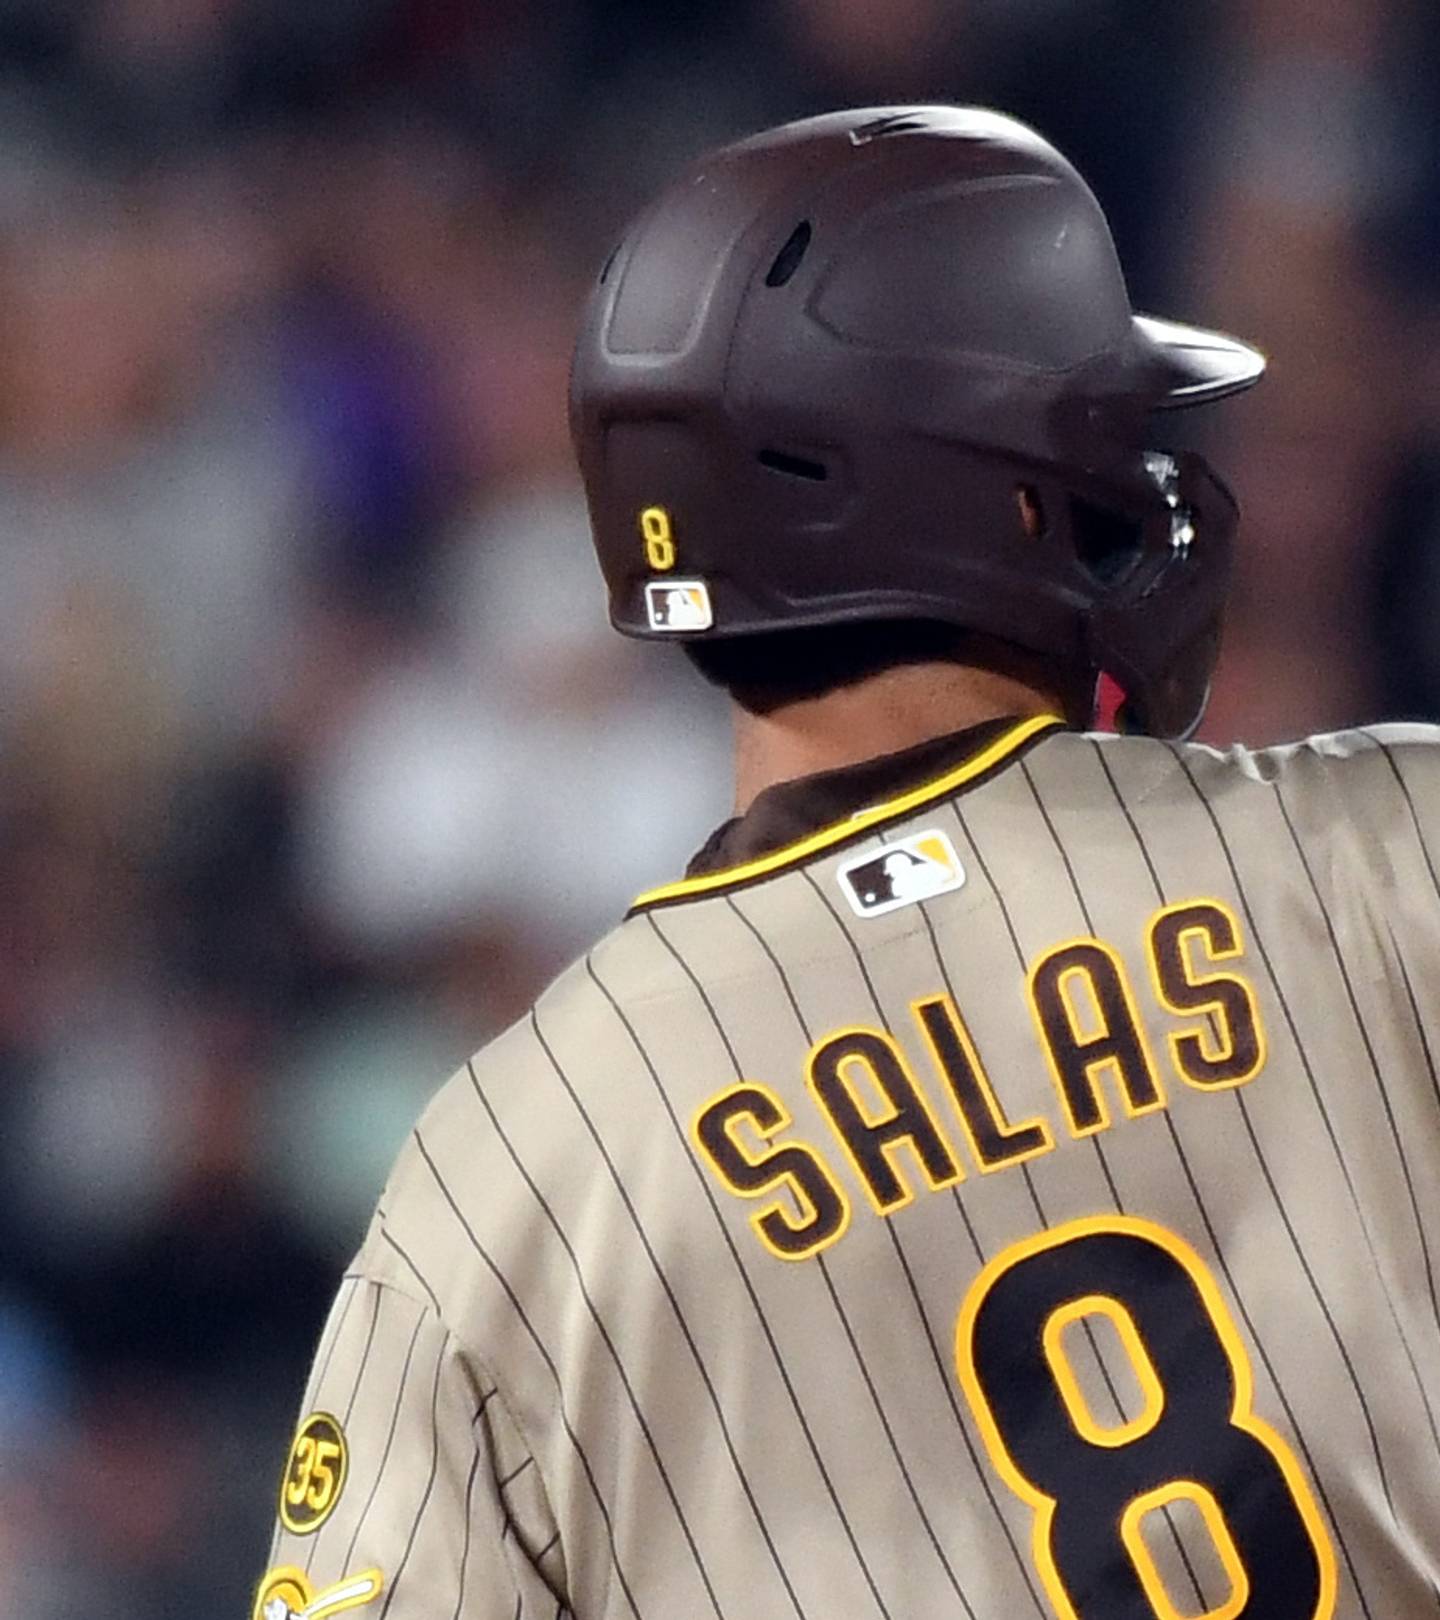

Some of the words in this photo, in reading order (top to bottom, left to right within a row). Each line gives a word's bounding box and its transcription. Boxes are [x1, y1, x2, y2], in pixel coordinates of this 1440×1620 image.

[641, 507, 675, 570] 8
[692, 897, 1268, 1261] SALAS
[287, 1436, 340, 1511] 35
[955, 1214, 1337, 1620] 8
